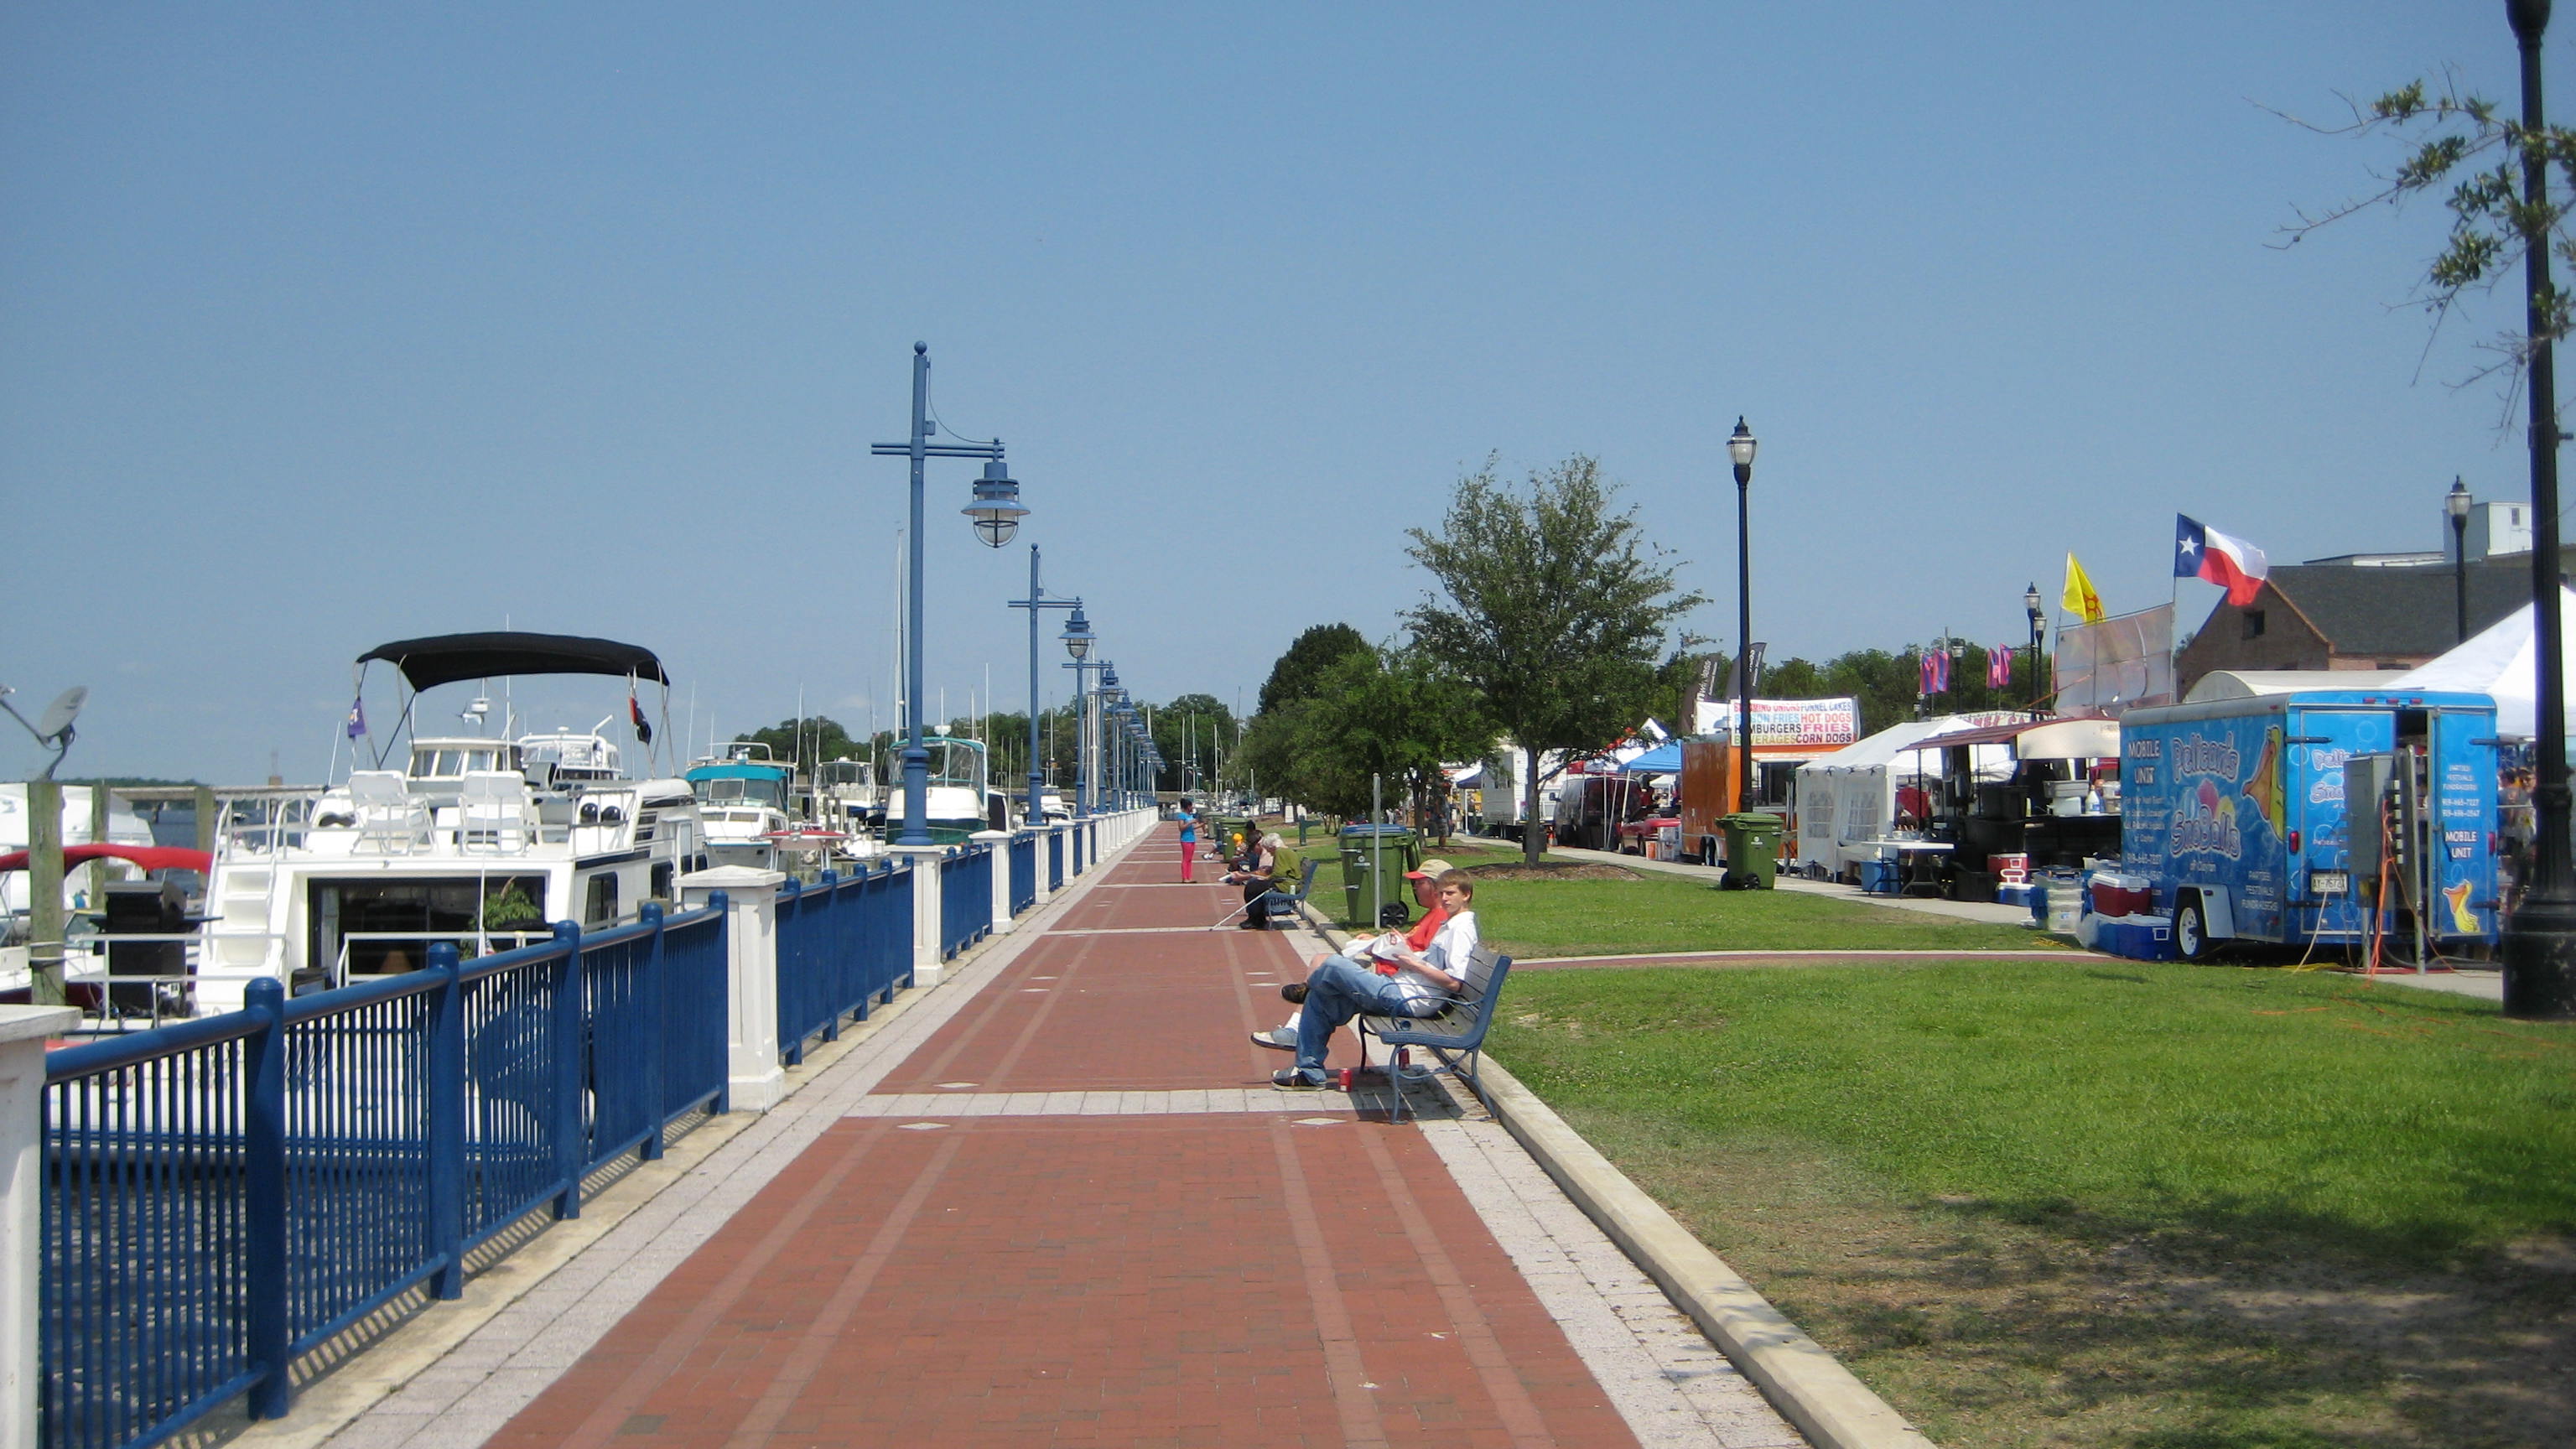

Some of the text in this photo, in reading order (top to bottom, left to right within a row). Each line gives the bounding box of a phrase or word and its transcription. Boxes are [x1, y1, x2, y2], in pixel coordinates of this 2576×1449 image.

[1801, 701, 1852, 712] FUNNEL CAKES
[1774, 713, 1800, 723] FRIES
[1800, 712, 1852, 723] HOT DOGS
[1803, 724, 1851, 733] FRIES
[1795, 733, 1852, 744] CORN DOGS
[2128, 740, 2161, 758] MOBILE
[2172, 730, 2240, 783] Pelican's
[2134, 766, 2156, 784] UNIT
[2170, 803, 2241, 861] SnoBalls
[2445, 830, 2478, 842] MOBILE
[2451, 847, 2473, 859] UNIT
